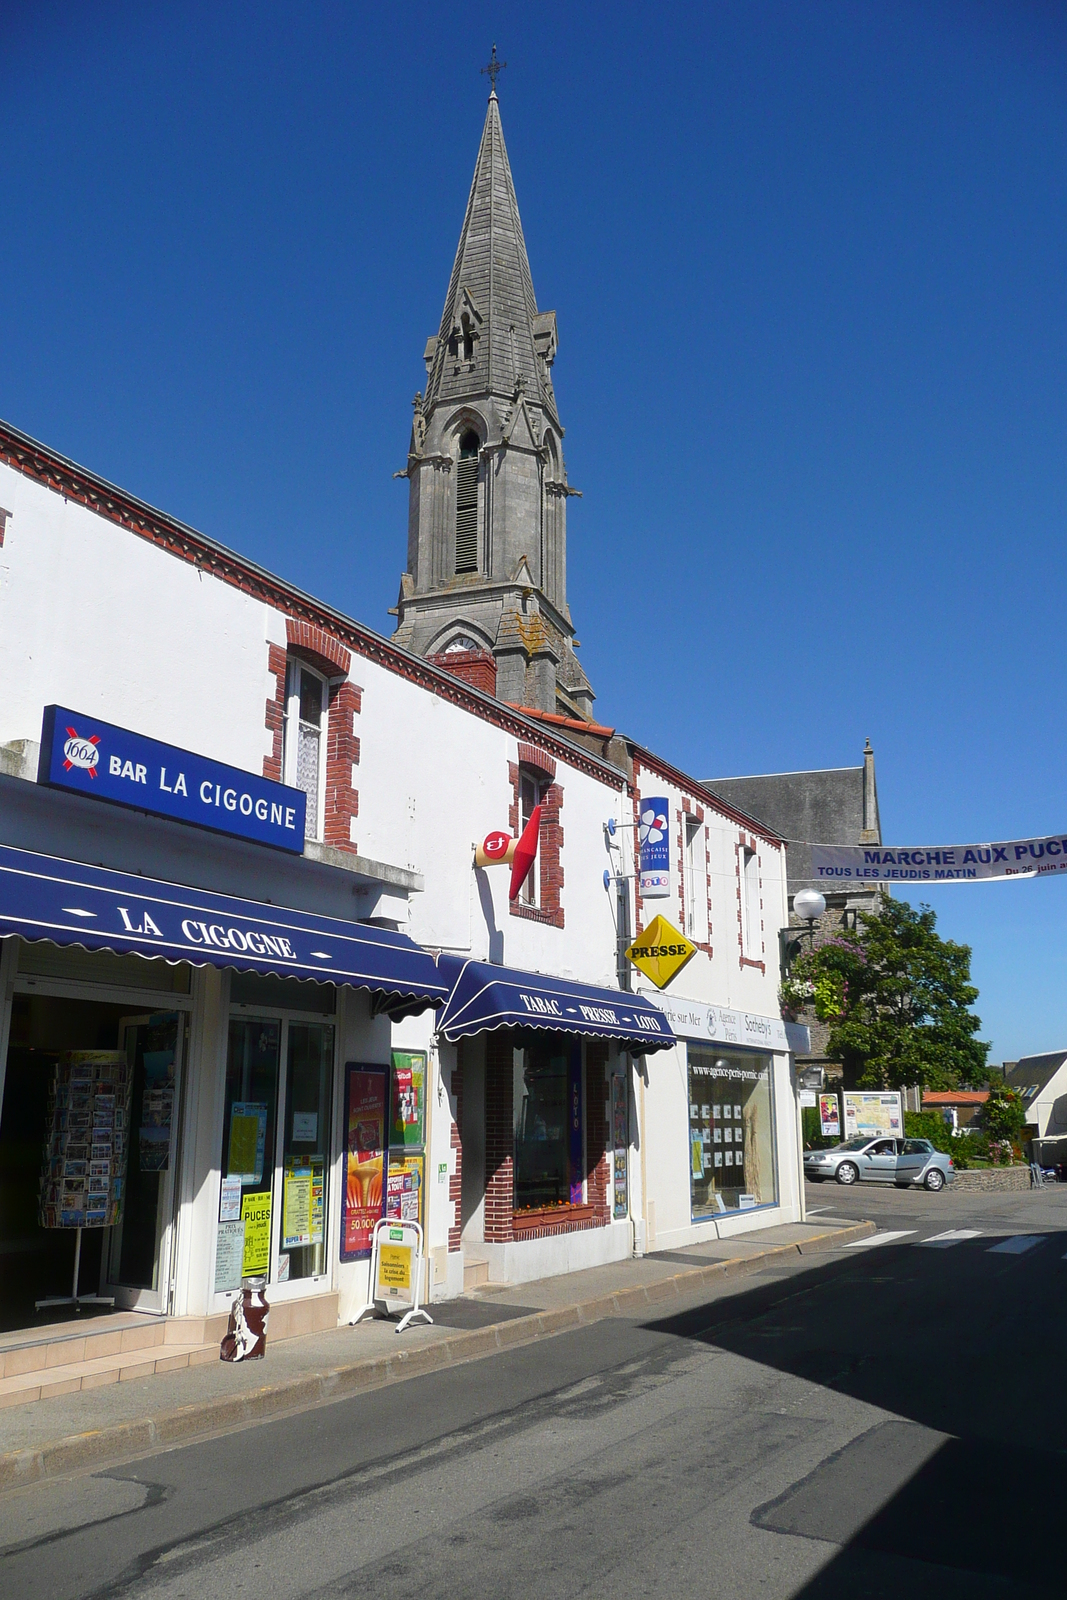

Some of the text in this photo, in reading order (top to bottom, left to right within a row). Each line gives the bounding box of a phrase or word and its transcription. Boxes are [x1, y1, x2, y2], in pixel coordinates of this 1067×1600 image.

[66, 741, 97, 764] 1664
[109, 755, 296, 830] BAR LA CIGOGNE
[864, 851, 955, 866] MARCHE
[963, 847, 1009, 864] AUX
[818, 867, 976, 878] TOUS LES JEUDIS MATIN
[1021, 865, 1033, 874] 26
[1037, 863, 1057, 873] juin
[117, 907, 297, 959] LA CIGOGNE
[631, 943, 687, 959] PRESSE
[519, 994, 662, 1031] TABAC PRESSE LOTO
[677, 1012, 688, 1025] sur
[688, 1012, 701, 1026] Mer
[718, 1010, 736, 1027] Agence
[745, 1014, 771, 1038] Sotheby's
[244, 1209, 271, 1222] PUCES
[351, 1218, 375, 1230] 50.000
